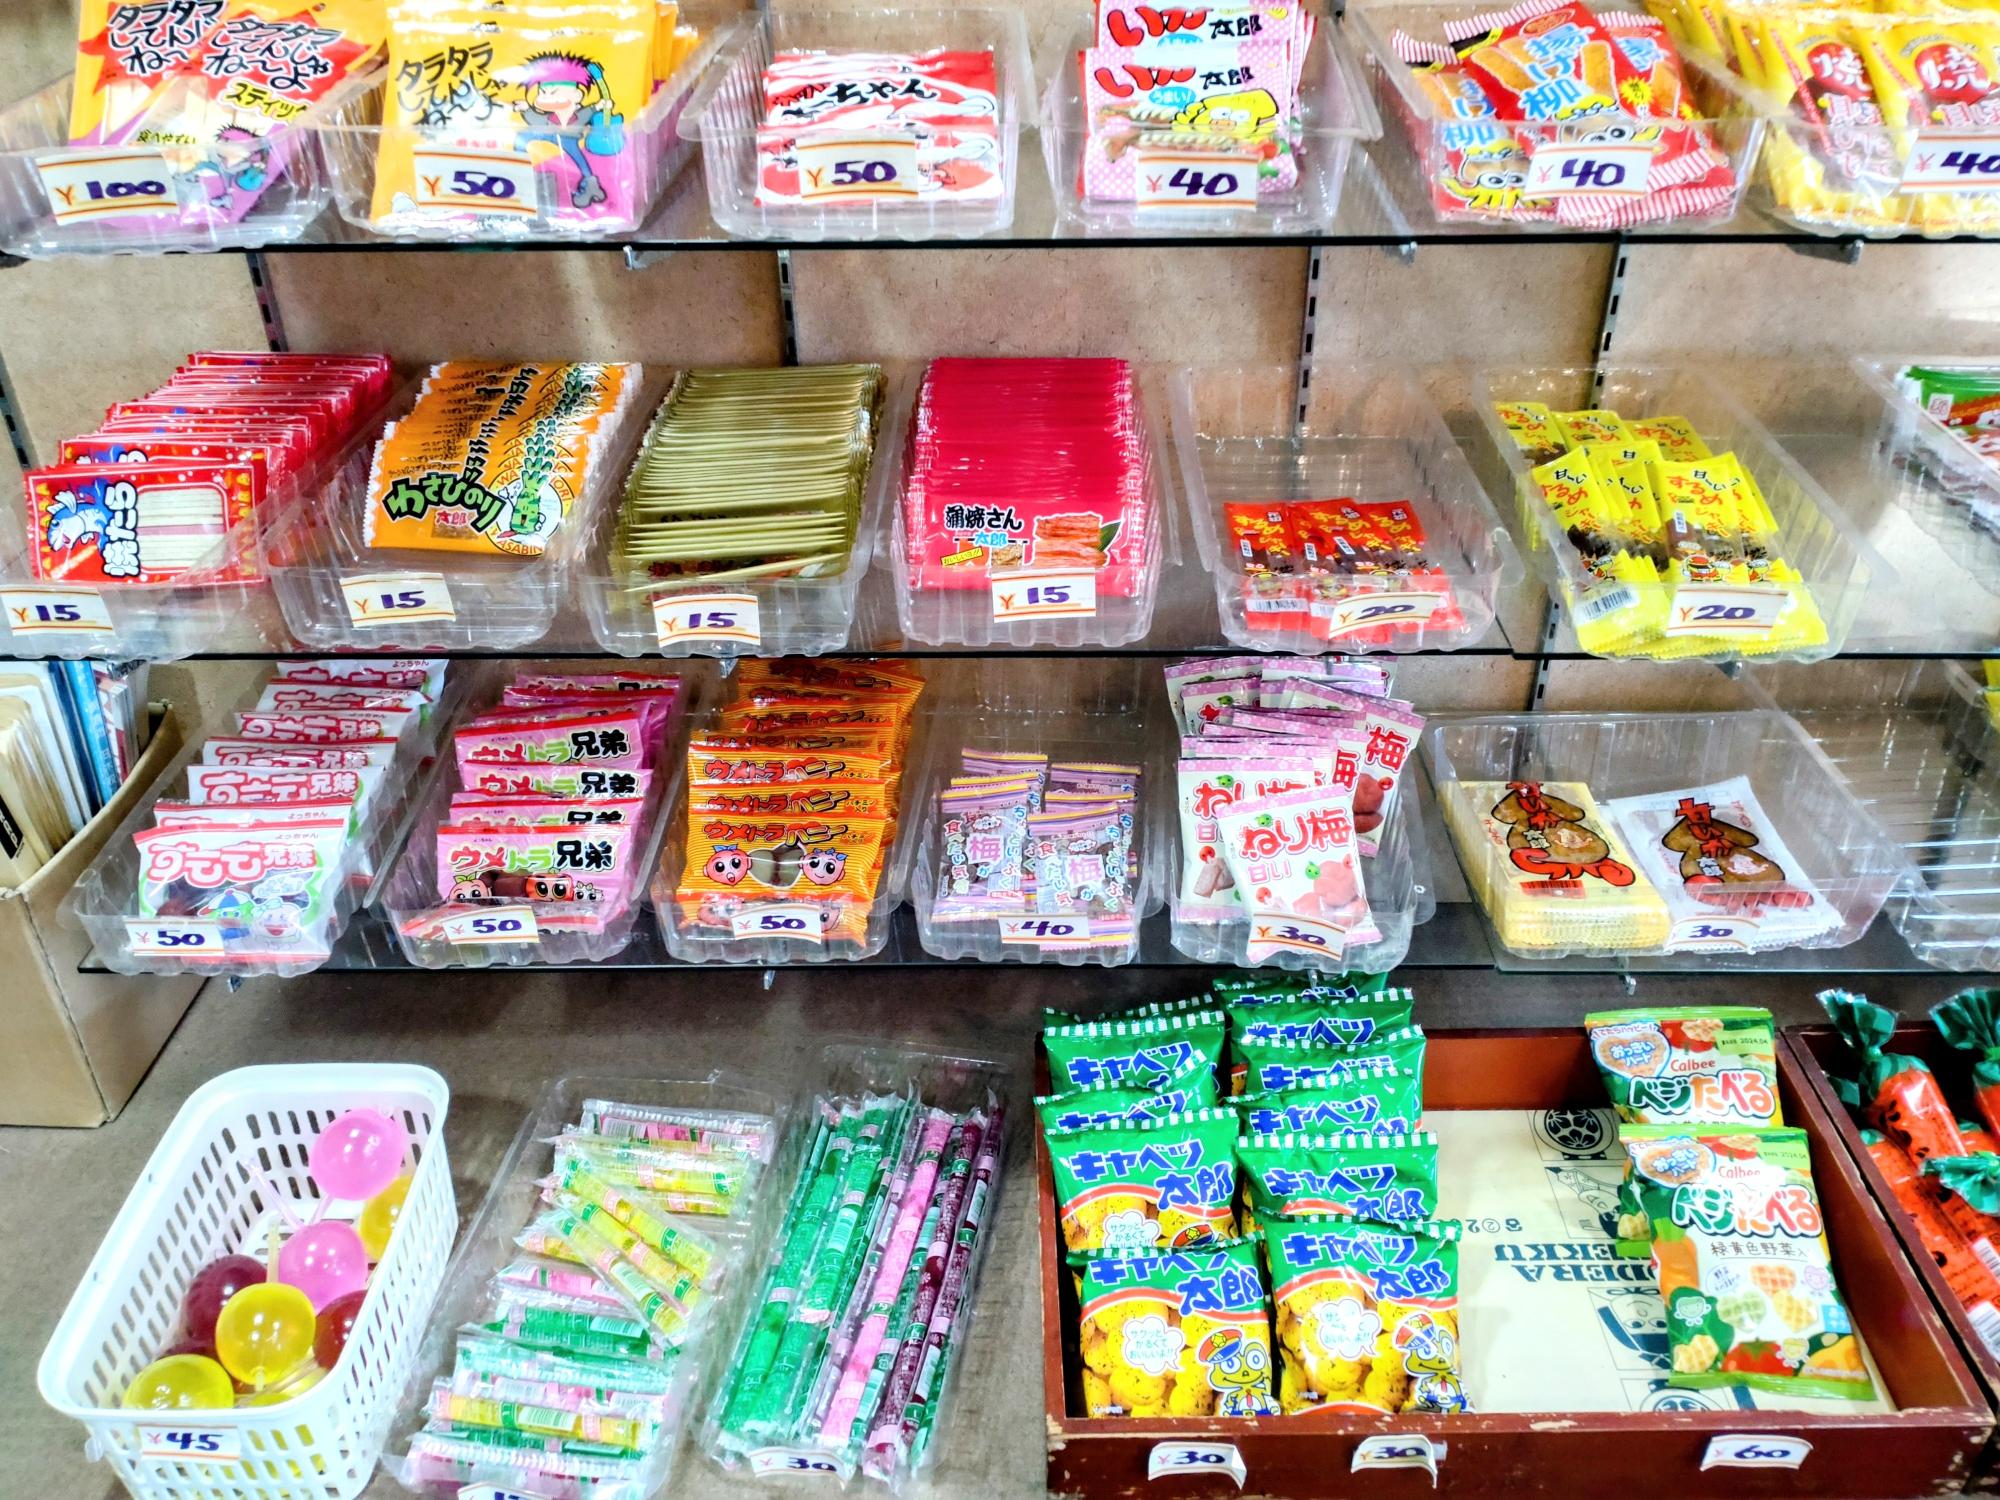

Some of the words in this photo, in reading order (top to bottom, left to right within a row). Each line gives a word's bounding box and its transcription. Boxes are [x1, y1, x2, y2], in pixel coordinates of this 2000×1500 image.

[385, 473, 505, 530] わさびのり
[436, 509, 468, 526] 太郎
[944, 505, 1024, 531] 蒲焼さん
[975, 532, 1008, 546] 太郎
[703, 820, 848, 846] ウメトラハニー
[1239, 808, 1352, 860] ねり梅
[450, 839, 615, 871] ウメトラ兄弟
[1248, 859, 1292, 885] 甘い
[1066, 1040, 1194, 1087] キャベツ
[1670, 1058, 1716, 1073] Calbee
[1629, 1071, 1775, 1119] ベジたべる
[1069, 1138, 1204, 1181] キャベツ
[1155, 1163, 1236, 1211] 太郎
[1262, 1162, 1398, 1198] キャベツ
[1283, 1232, 1418, 1267] キャベツ
[1175, 1266, 1264, 1316] 太郎
[1367, 1259, 1452, 1302] 太郎
